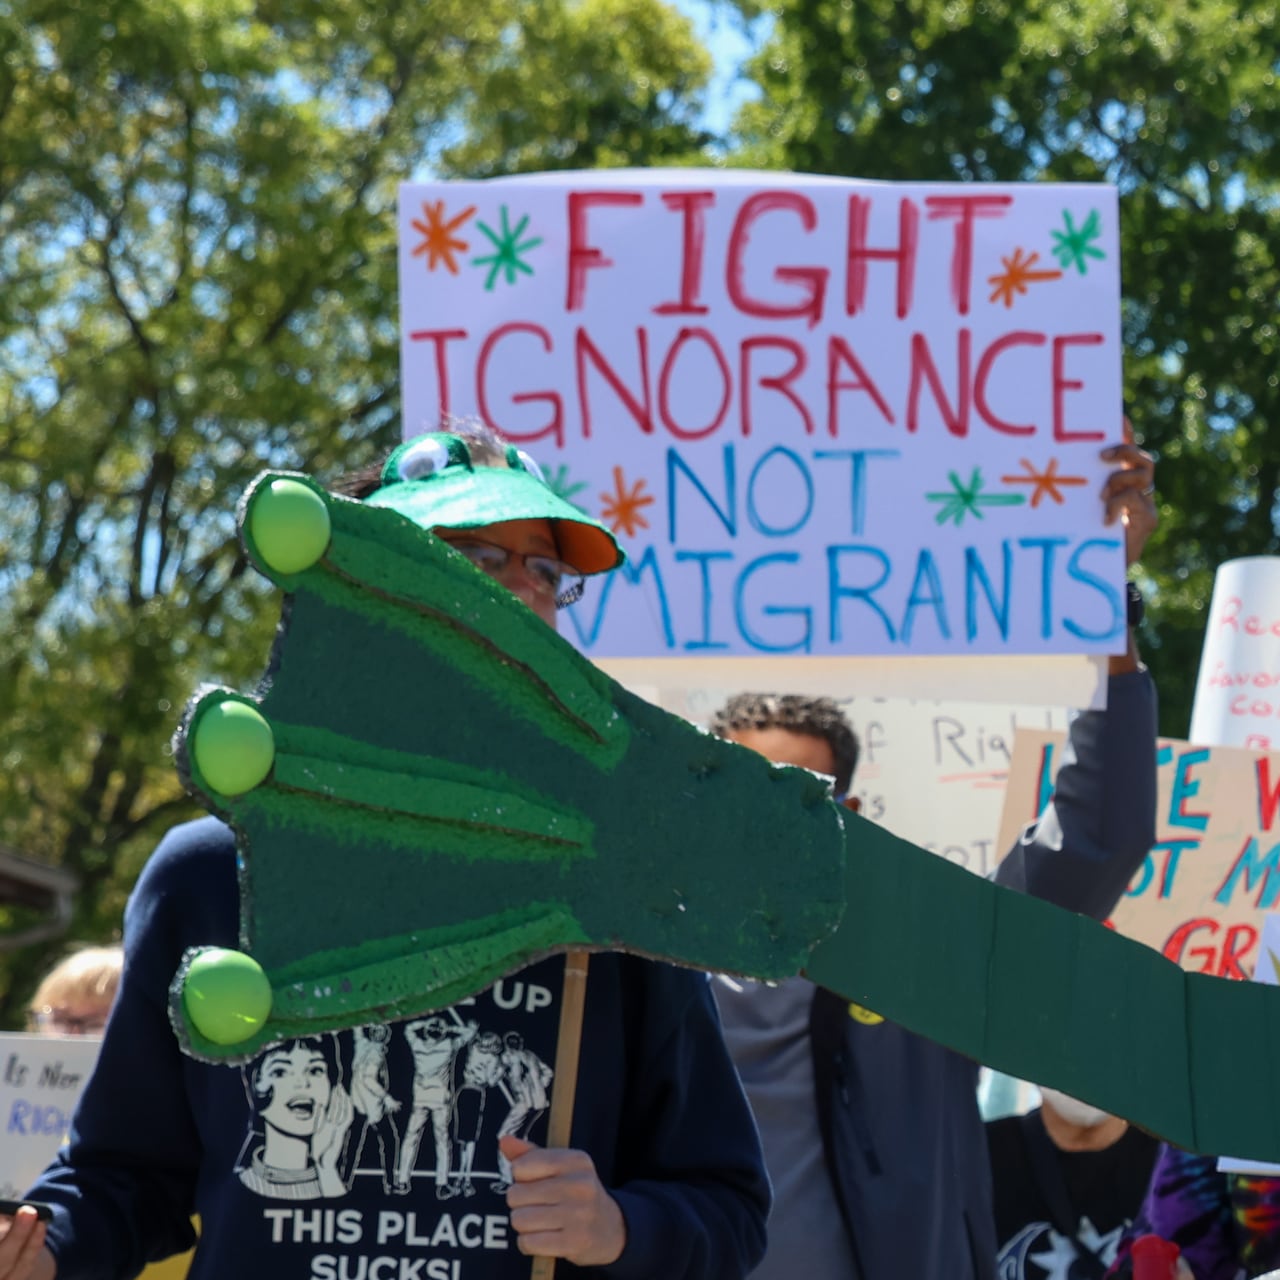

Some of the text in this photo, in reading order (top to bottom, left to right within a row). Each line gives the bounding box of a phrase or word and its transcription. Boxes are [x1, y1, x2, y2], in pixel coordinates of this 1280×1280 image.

[566, 190, 1013, 329] FIGHT
[410, 322, 1105, 448] IGNORANCE
[665, 442, 900, 544] NOT
[556, 537, 1124, 655] MIGRANTS
[491, 979, 553, 1014] UP
[263, 1208, 510, 1250] THIS PLACE
